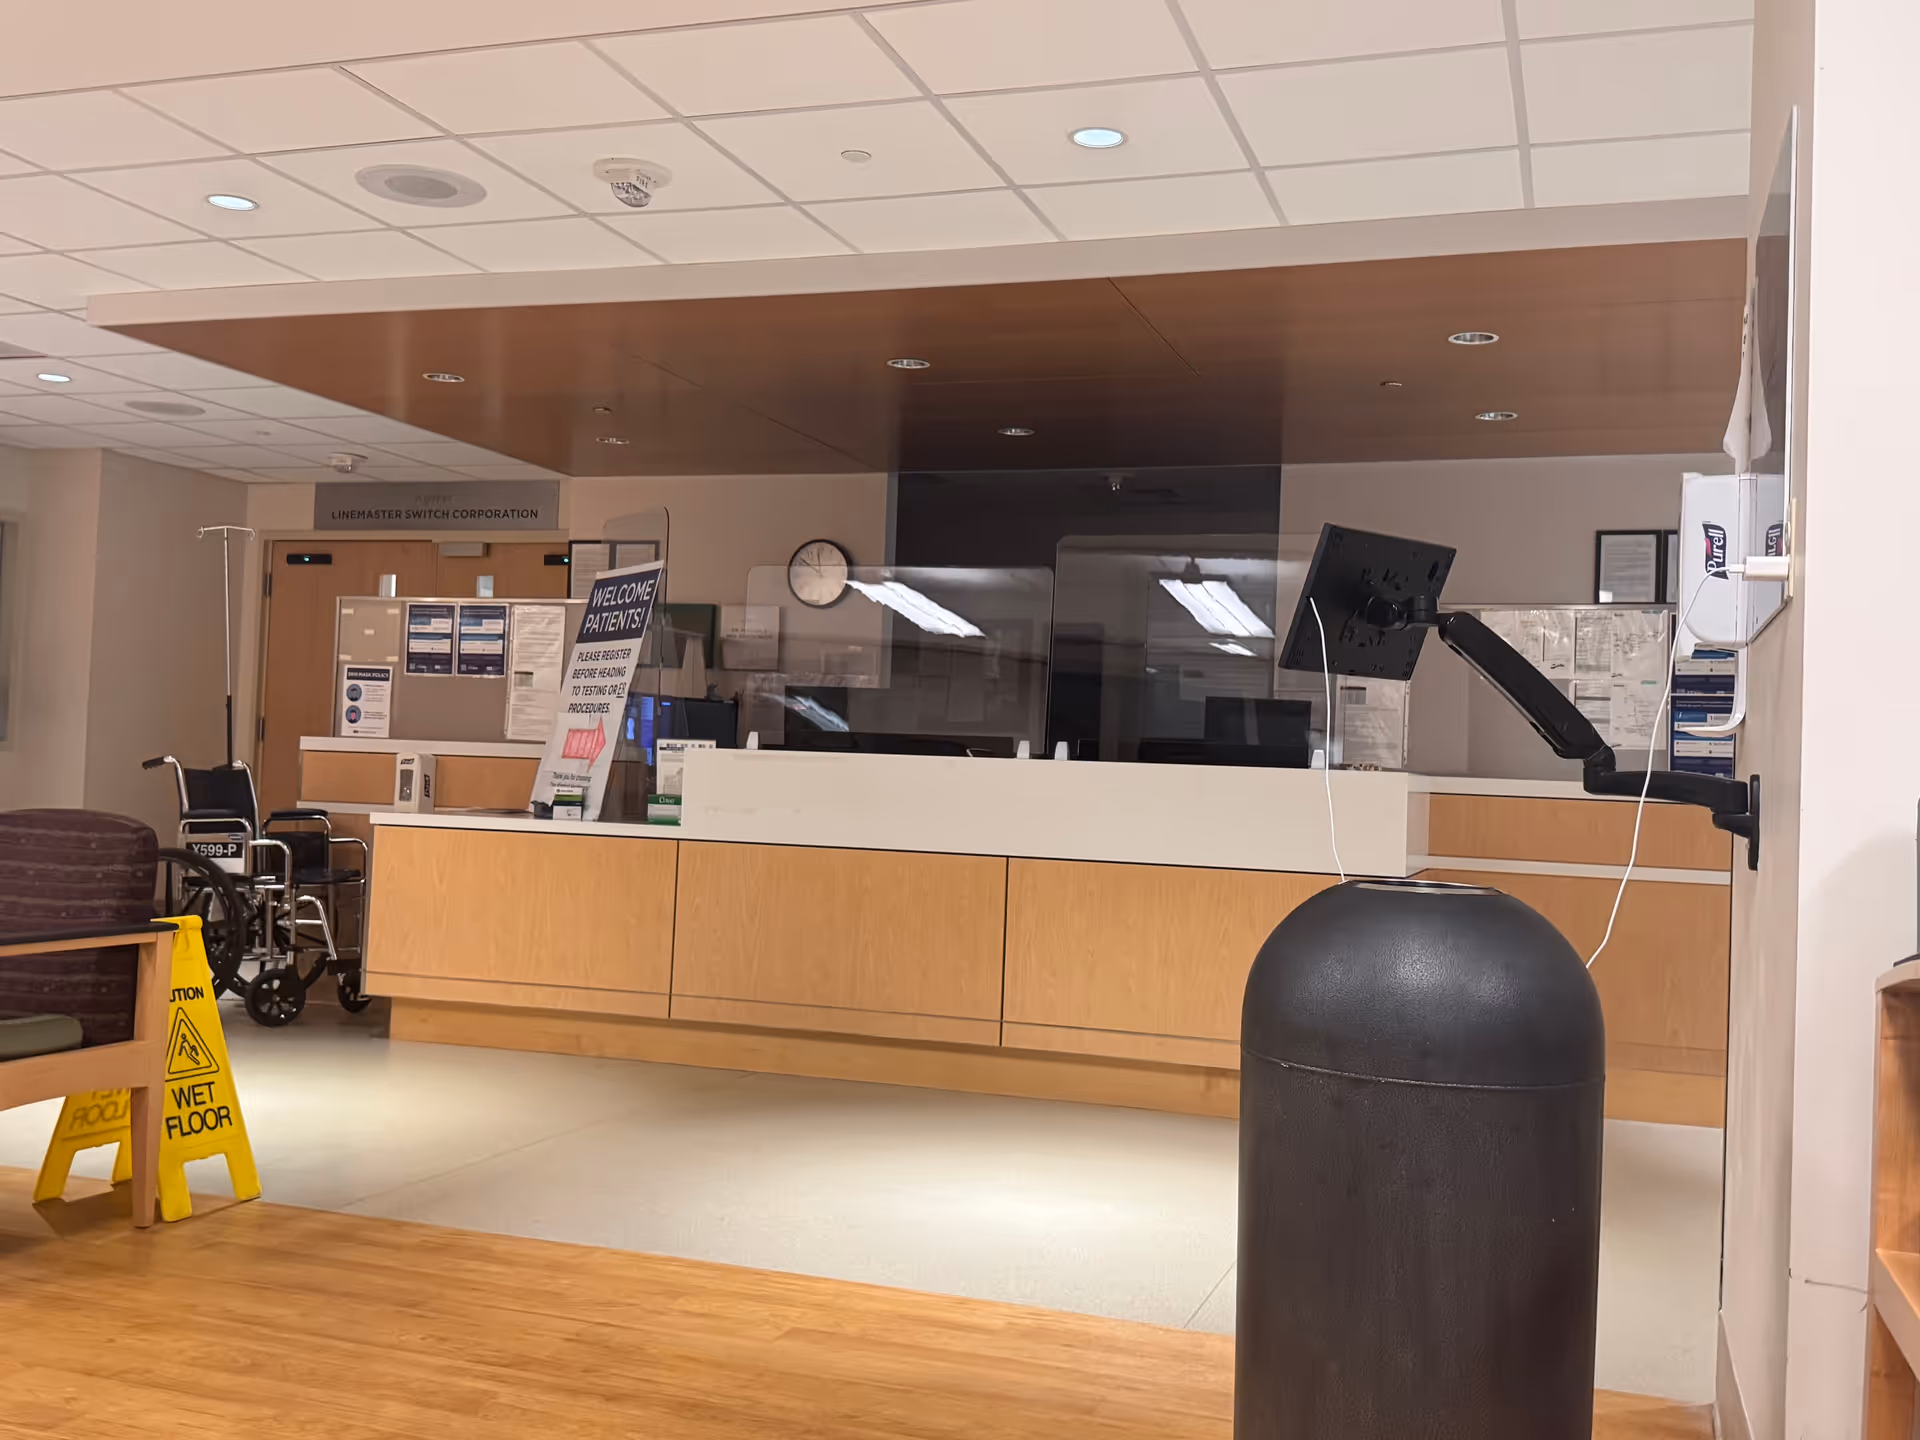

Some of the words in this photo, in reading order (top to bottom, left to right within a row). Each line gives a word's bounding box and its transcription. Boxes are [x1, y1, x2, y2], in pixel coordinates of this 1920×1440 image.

[332, 509, 401, 520] LINEMASTER
[405, 509, 450, 520] SWITCH
[452, 509, 539, 519] CORPORATION
[1707, 528, 1724, 573] Purell
[592, 580, 655, 608] WELCOME
[583, 607, 646, 634] PATIENTS!
[577, 650, 602, 662] PLEASE
[601, 648, 631, 661] REGISTER
[572, 668, 598, 679] BEFORE
[597, 666, 627, 679] HEADING
[571, 685, 581, 696] TO
[581, 684, 608, 696] TESTING
[608, 685, 617, 696] OR
[171, 1081, 215, 1110] WET
[165, 1105, 233, 1140] FLOOR
